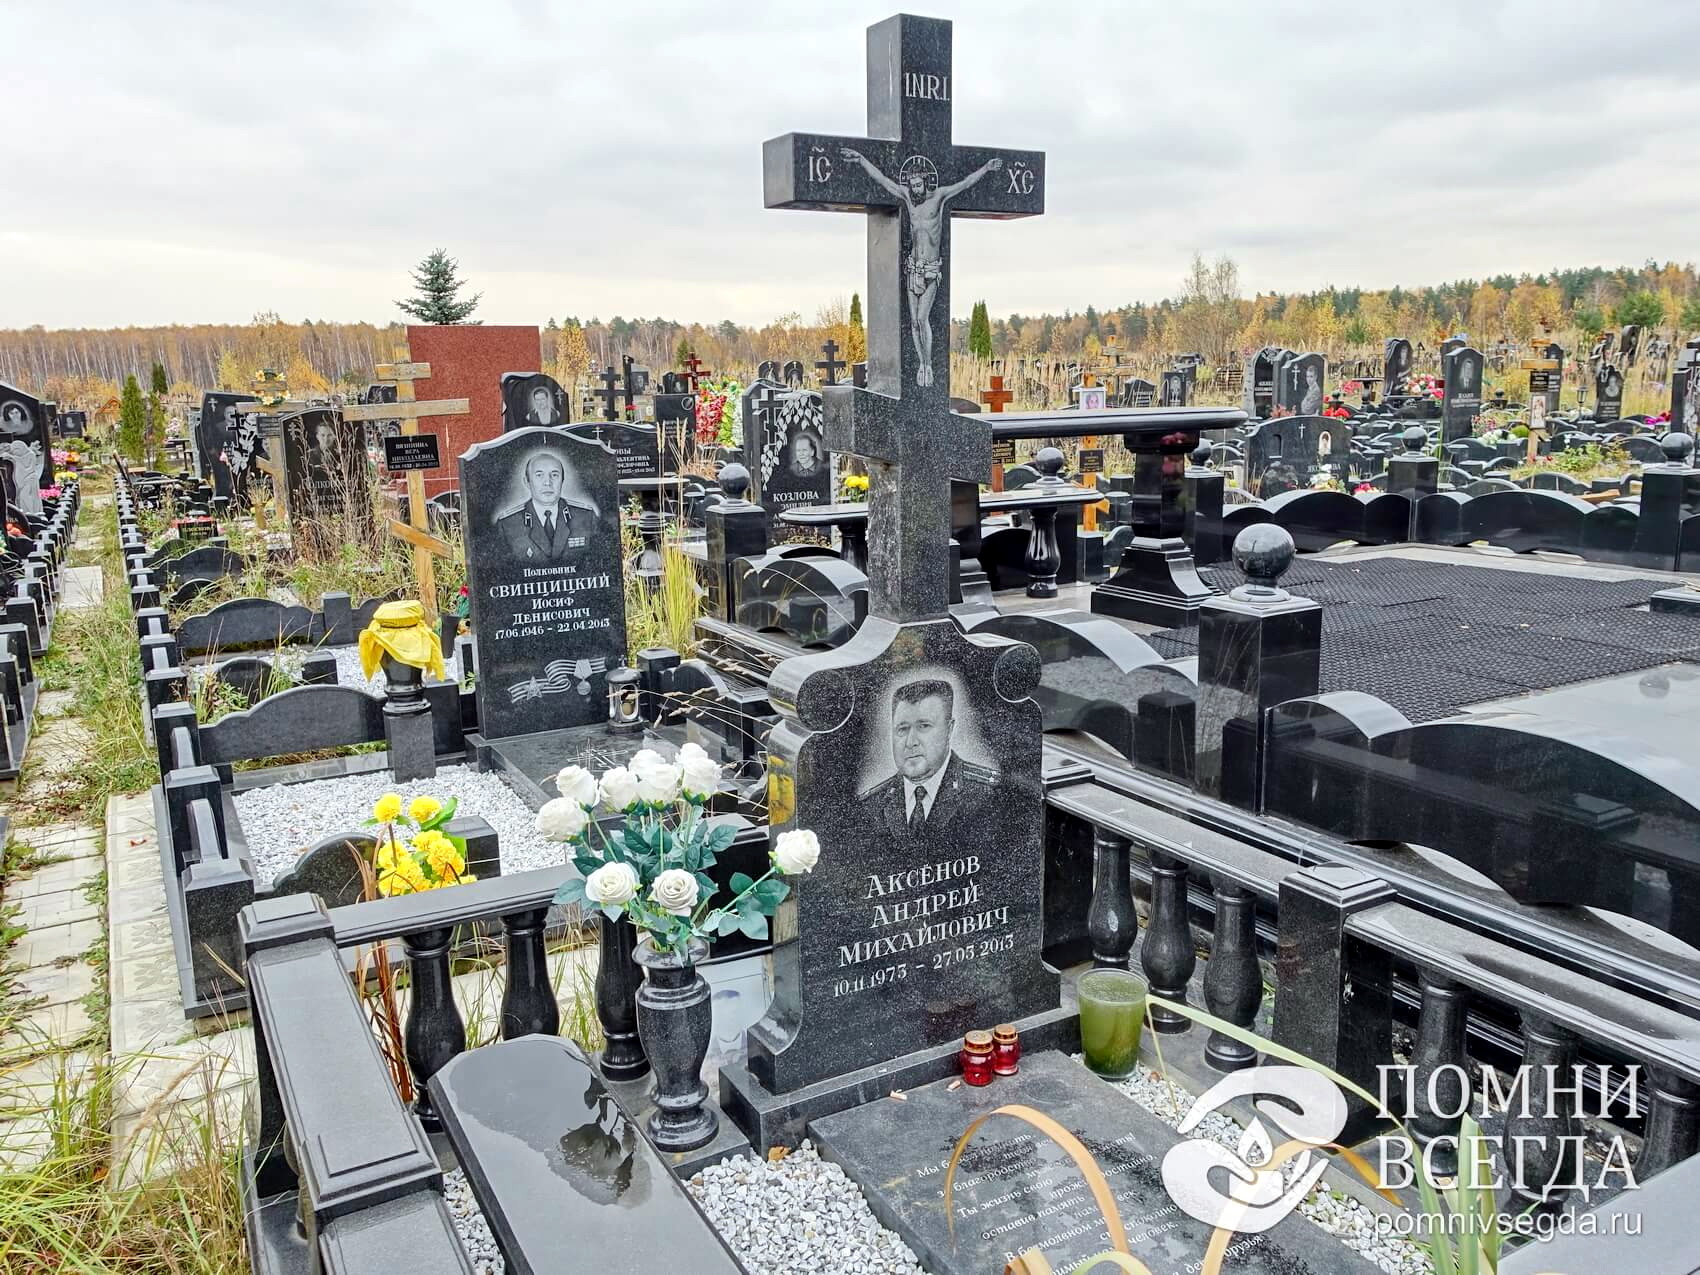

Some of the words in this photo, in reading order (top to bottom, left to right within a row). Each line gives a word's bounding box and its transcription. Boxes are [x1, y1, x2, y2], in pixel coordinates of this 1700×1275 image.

[773, 491, 819, 502] КОЗЛОВА
[489, 572, 610, 598] СВИНЦИЦКИЙ
[512, 607, 590, 626] ДЕНИСОВИЧ
[557, 618, 610, 633] 22.04.2013
[869, 878, 981, 929] АНДРЕЙ
[837, 906, 1010, 968] МИХАЙЛОВИЧ
[933, 934, 1014, 970] 27.03.2013
[916, 1165, 940, 1178] Мы
[957, 1207, 979, 1218] Ты
[980, 1189, 1022, 1210] жизнь
[1023, 1178, 1053, 1195] свою
[982, 1213, 1036, 1240] оставив
[1038, 1195, 1086, 1217] память
[1005, 1251, 1016, 1263] В
